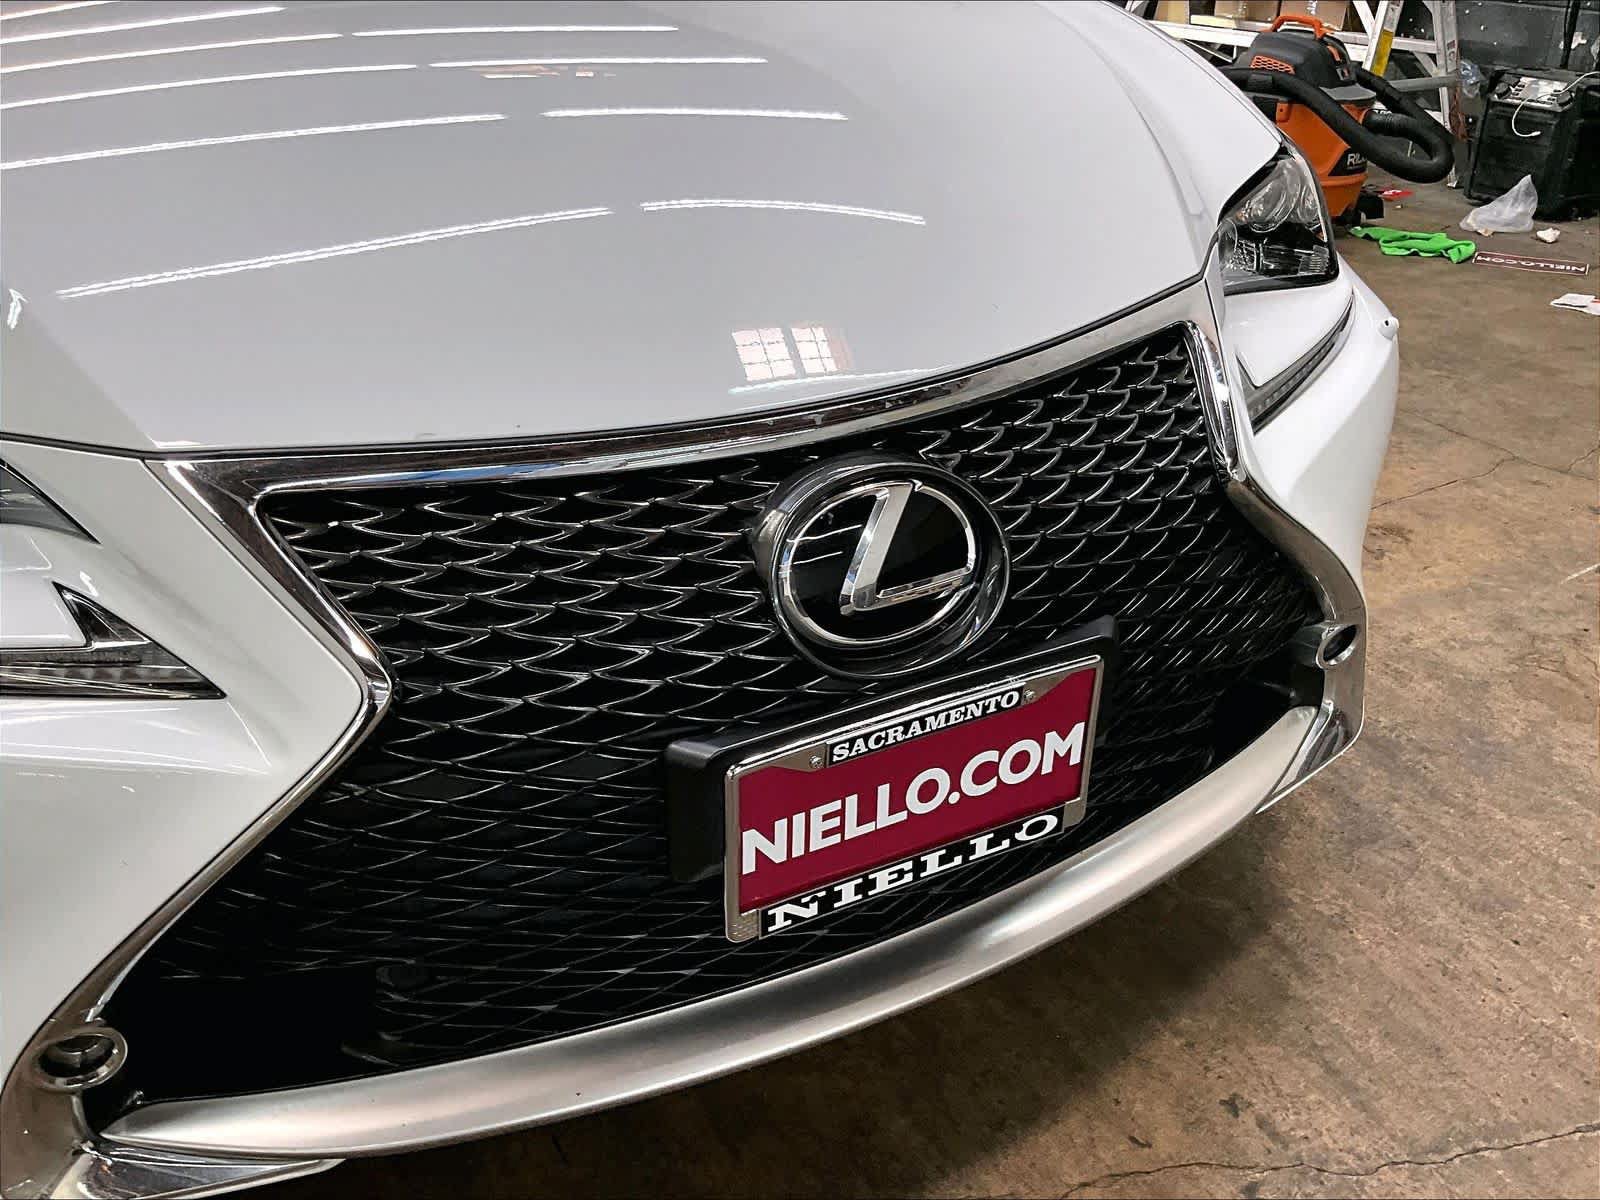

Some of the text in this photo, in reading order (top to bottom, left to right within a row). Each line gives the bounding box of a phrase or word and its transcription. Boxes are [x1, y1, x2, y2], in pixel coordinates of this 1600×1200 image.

[832, 690, 1021, 762] SACRAMENTO
[741, 721, 1086, 876] NIELLO.COM
[767, 814, 1059, 933] NIELLO
